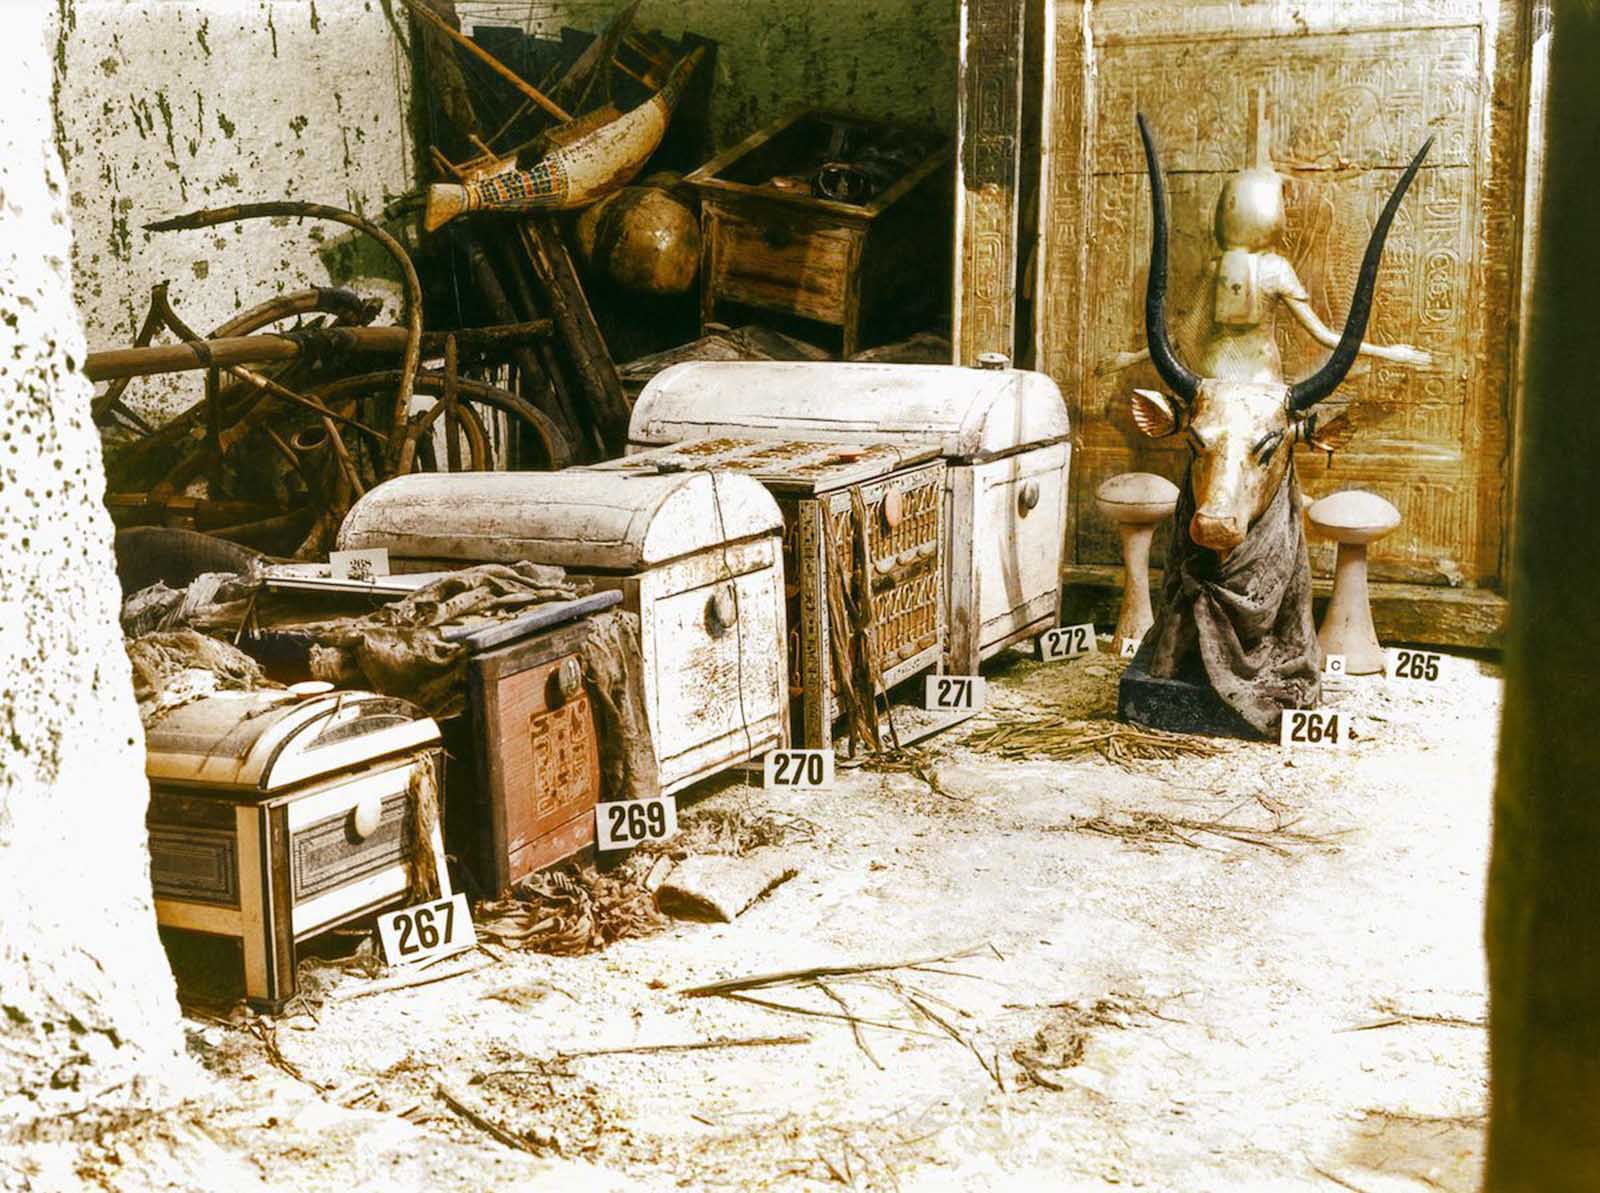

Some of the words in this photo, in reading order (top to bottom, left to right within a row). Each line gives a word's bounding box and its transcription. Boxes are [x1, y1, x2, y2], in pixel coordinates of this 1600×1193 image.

[1048, 628, 1089, 657] 272
[1126, 644, 1134, 654] A
[1331, 661, 1342, 671] C
[1396, 651, 1440, 681] 265
[937, 679, 973, 708] 271
[1291, 712, 1339, 743] 264
[774, 753, 824, 785] 270
[609, 801, 666, 843] 269
[393, 901, 454, 956] 267
